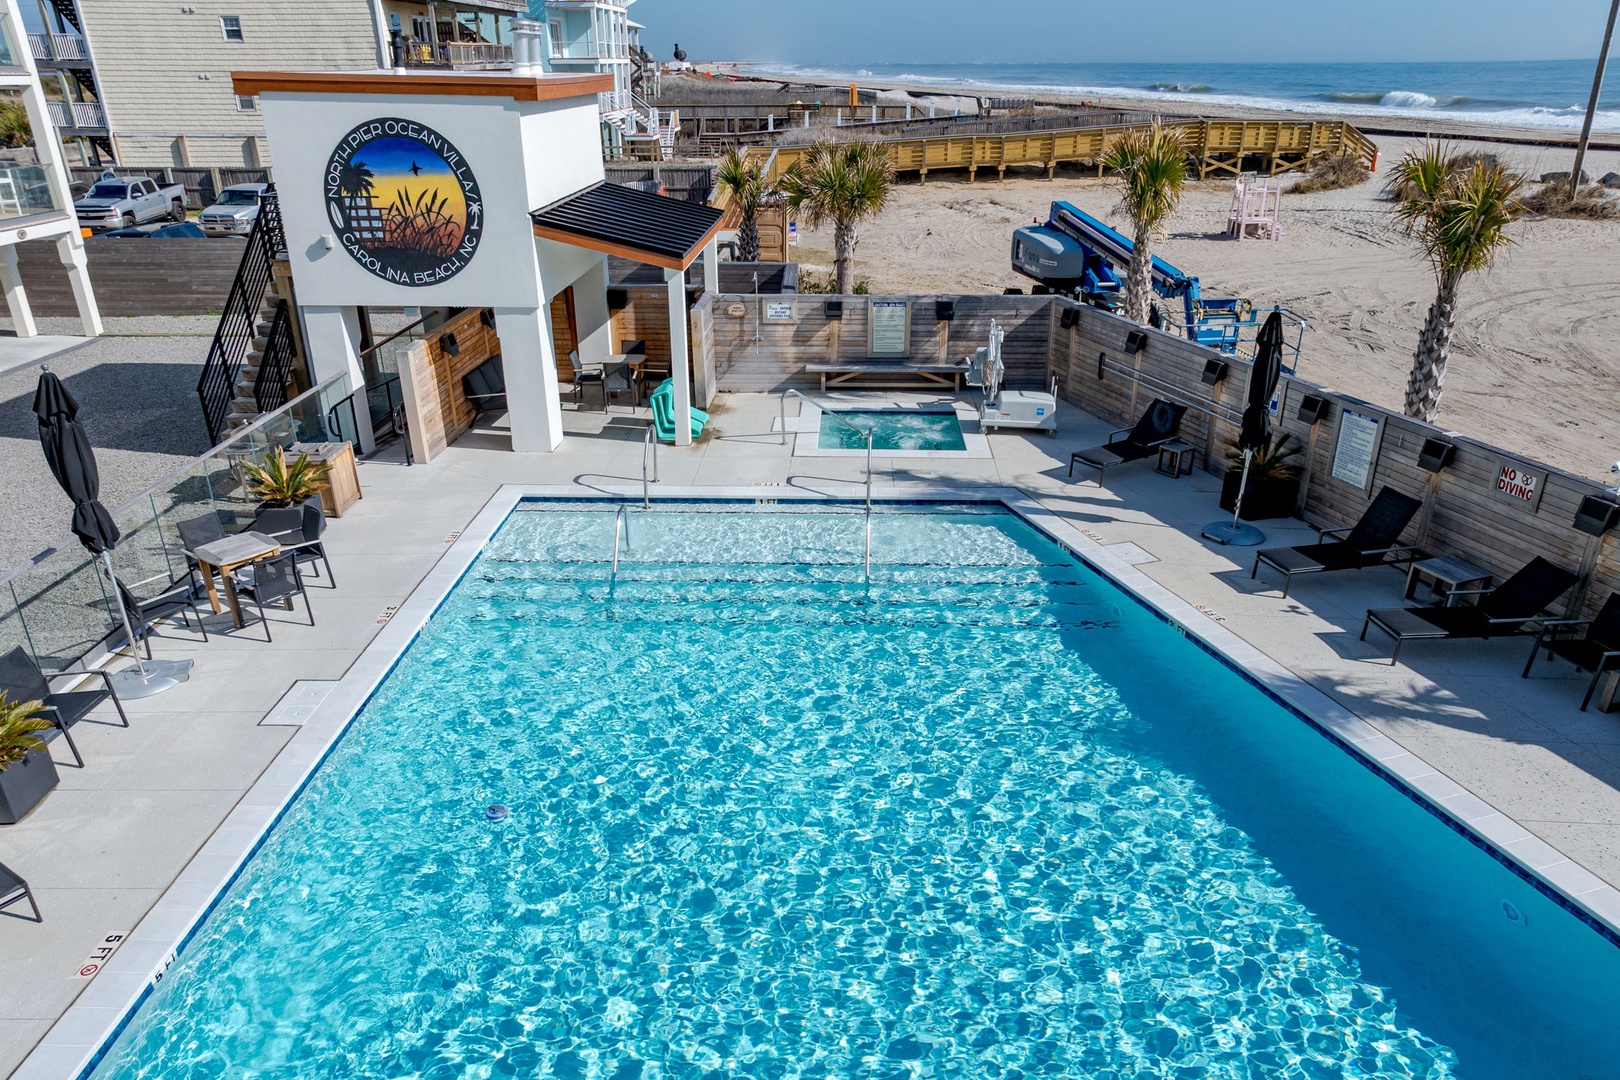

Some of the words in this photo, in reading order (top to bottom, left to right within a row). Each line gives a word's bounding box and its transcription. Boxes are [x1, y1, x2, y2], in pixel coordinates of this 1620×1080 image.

[327, 143, 352, 198] NORTH
[348, 122, 383, 149] PIER
[384, 120, 442, 150] OCEAN
[342, 233, 411, 284] CAROLINA
[413, 257, 466, 284] BEACH,
[459, 234, 477, 259] NC
[1500, 466, 1517, 482] NO
[1497, 478, 1534, 501] DIVING
[104, 934, 124, 943] 5
[90, 947, 114, 961] FT
